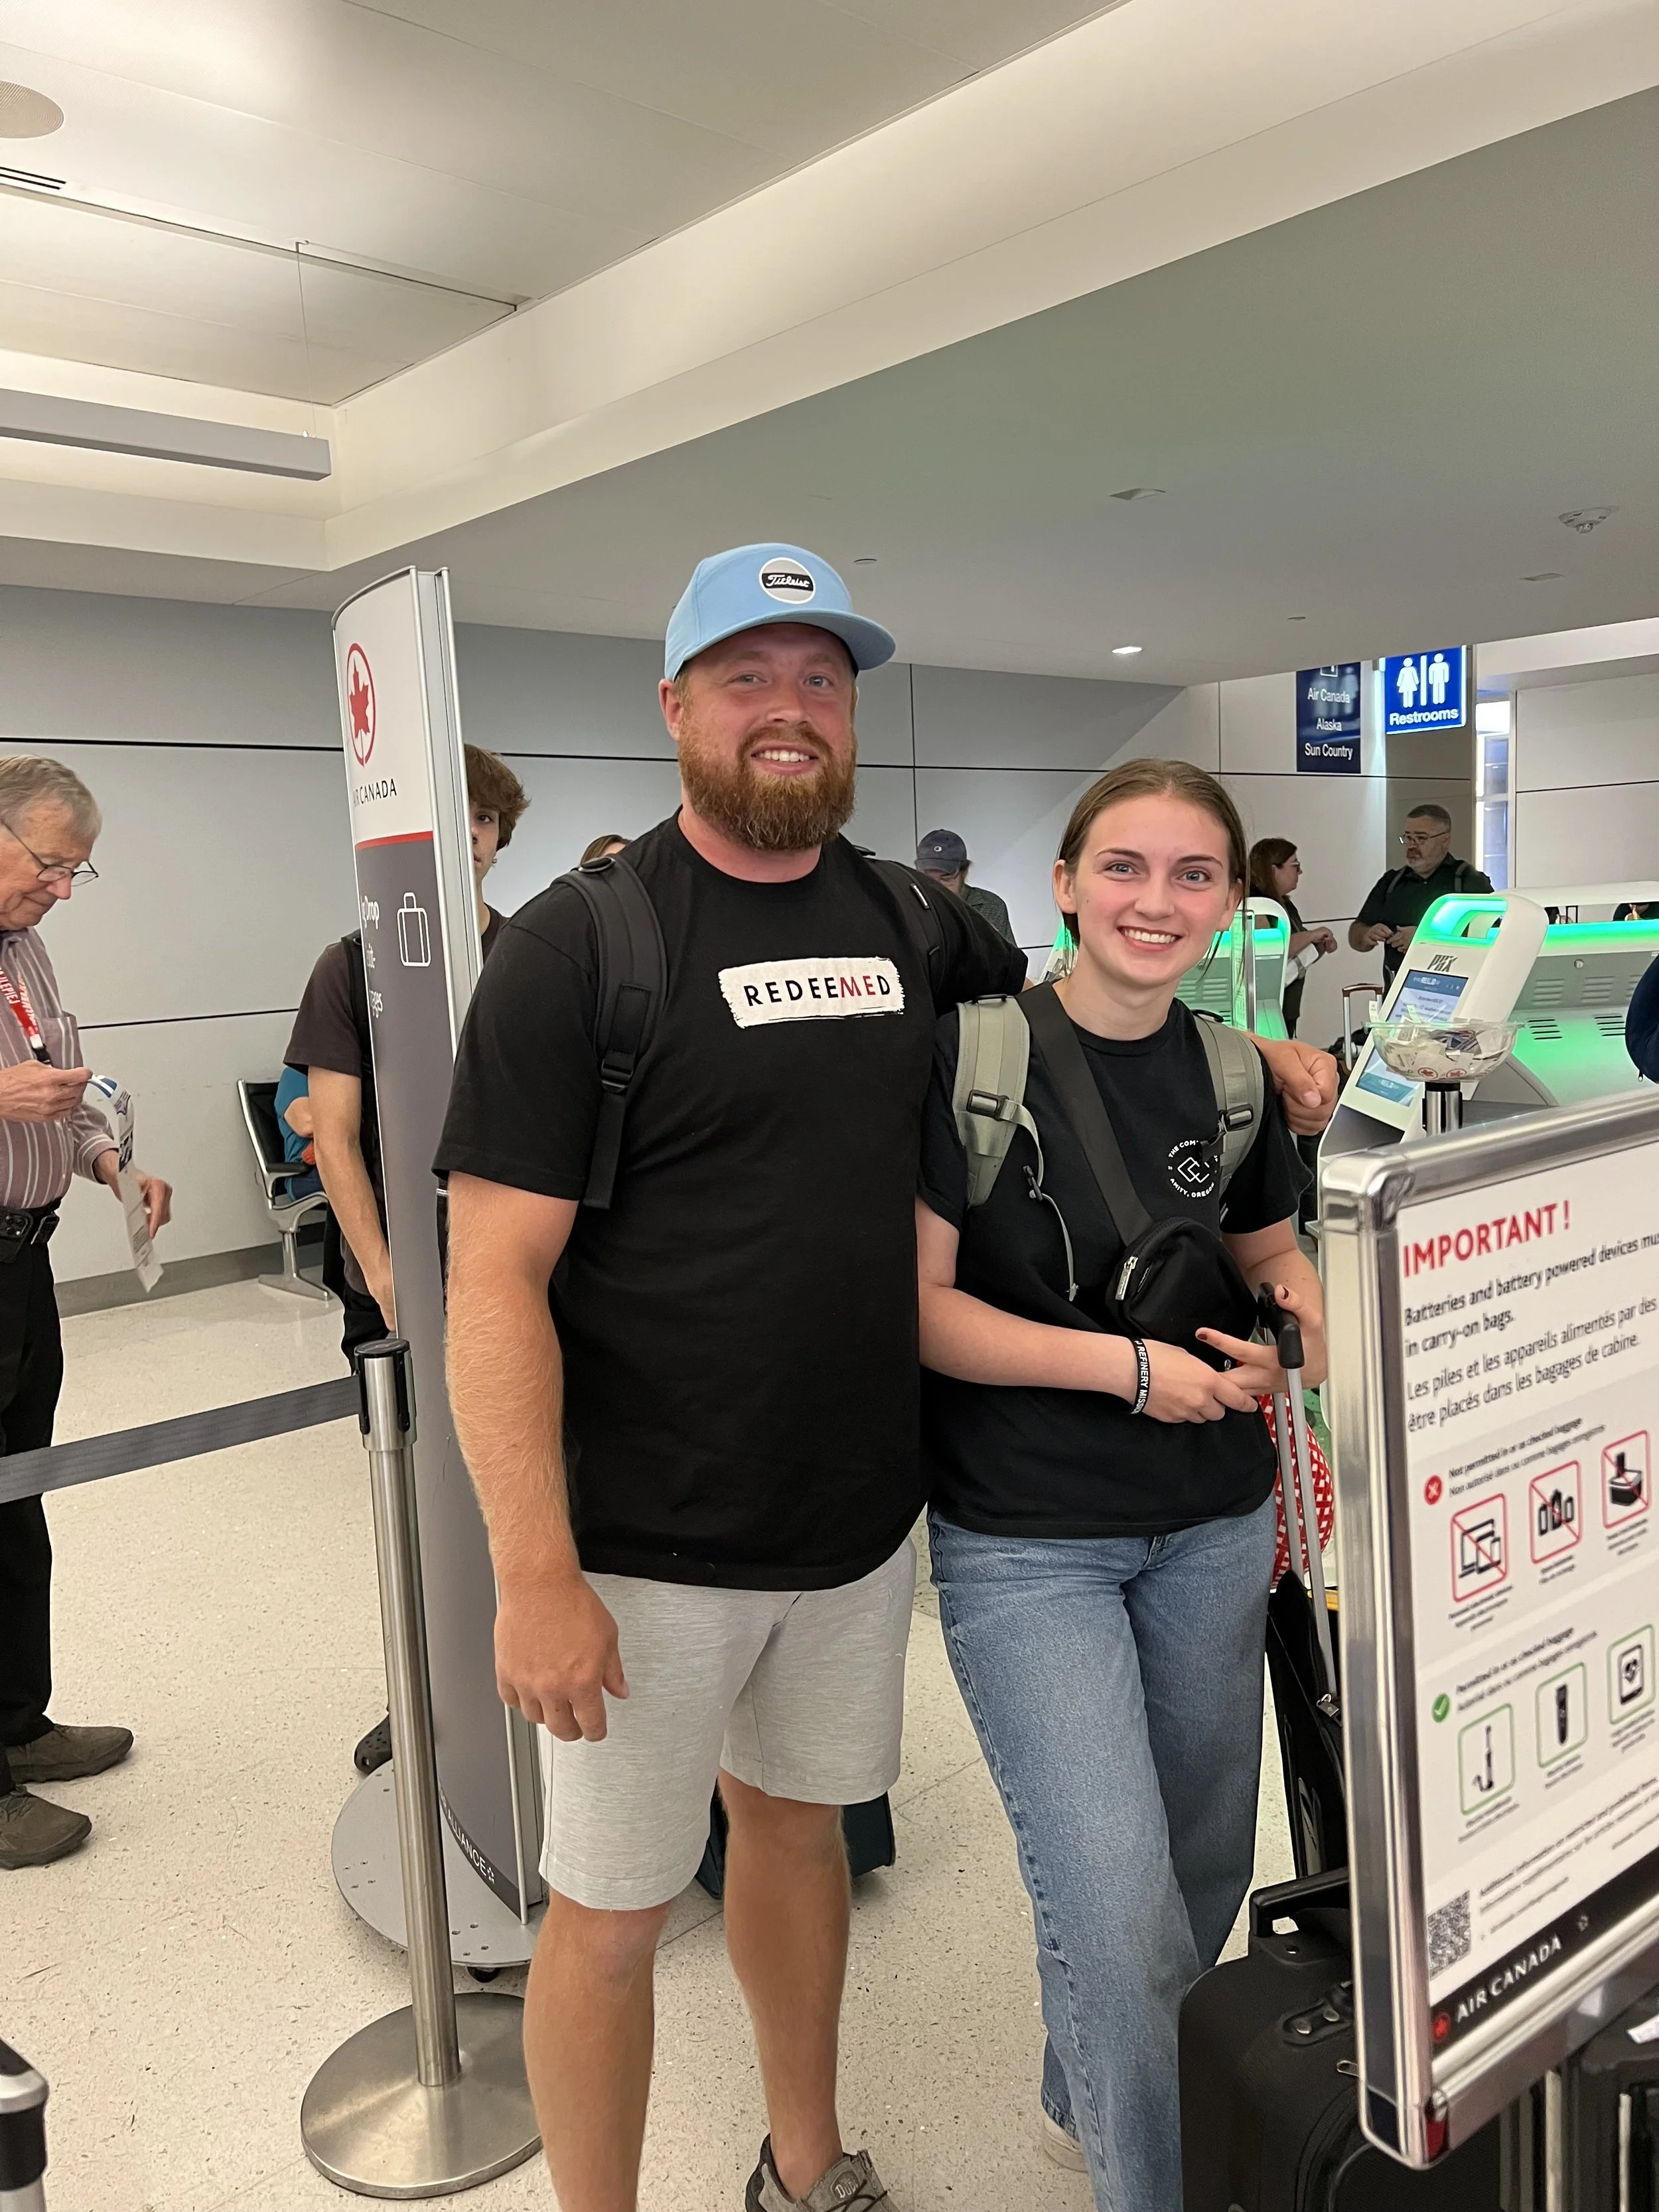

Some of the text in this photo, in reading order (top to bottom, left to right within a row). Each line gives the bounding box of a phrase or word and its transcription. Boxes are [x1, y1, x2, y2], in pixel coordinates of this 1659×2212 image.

[765, 574, 810, 588] Titleist
[1307, 687, 1350, 703] Air Canada
[1316, 717, 1342, 731] Alaska
[1390, 708, 1459, 726] Restrooms
[1305, 743, 1353, 761] Sun Country
[360, 778, 397, 804] CANADA
[743, 974, 891, 1007] REDEEMED
[1168, 1140, 1199, 1158] THE COM
[1170, 1178, 1215, 1199] AMITY, OREGON
[1403, 1203, 1558, 1278] IMPORTANT
[1404, 1293, 1466, 1327] Batteries
[1469, 1279, 1493, 1305] and
[1496, 1269, 1543, 1297] battery
[1545, 1248, 1597, 1286] powered
[1598, 1239, 1639, 1262] devices
[1405, 1309, 1516, 1358] in carry-on bags.
[1407, 1296, 1657, 1400] Les piles et les appareils alimentés par des
[1137, 1346, 1149, 1388] REFINERY
[1407, 1332, 1642, 1433] être placés dans les bagages de cabine.
[447, 1808, 487, 1877] ALLIANCE
[1455, 1933, 1563, 2024] AIR CANADA
[835, 2180, 859, 2199] DUD
